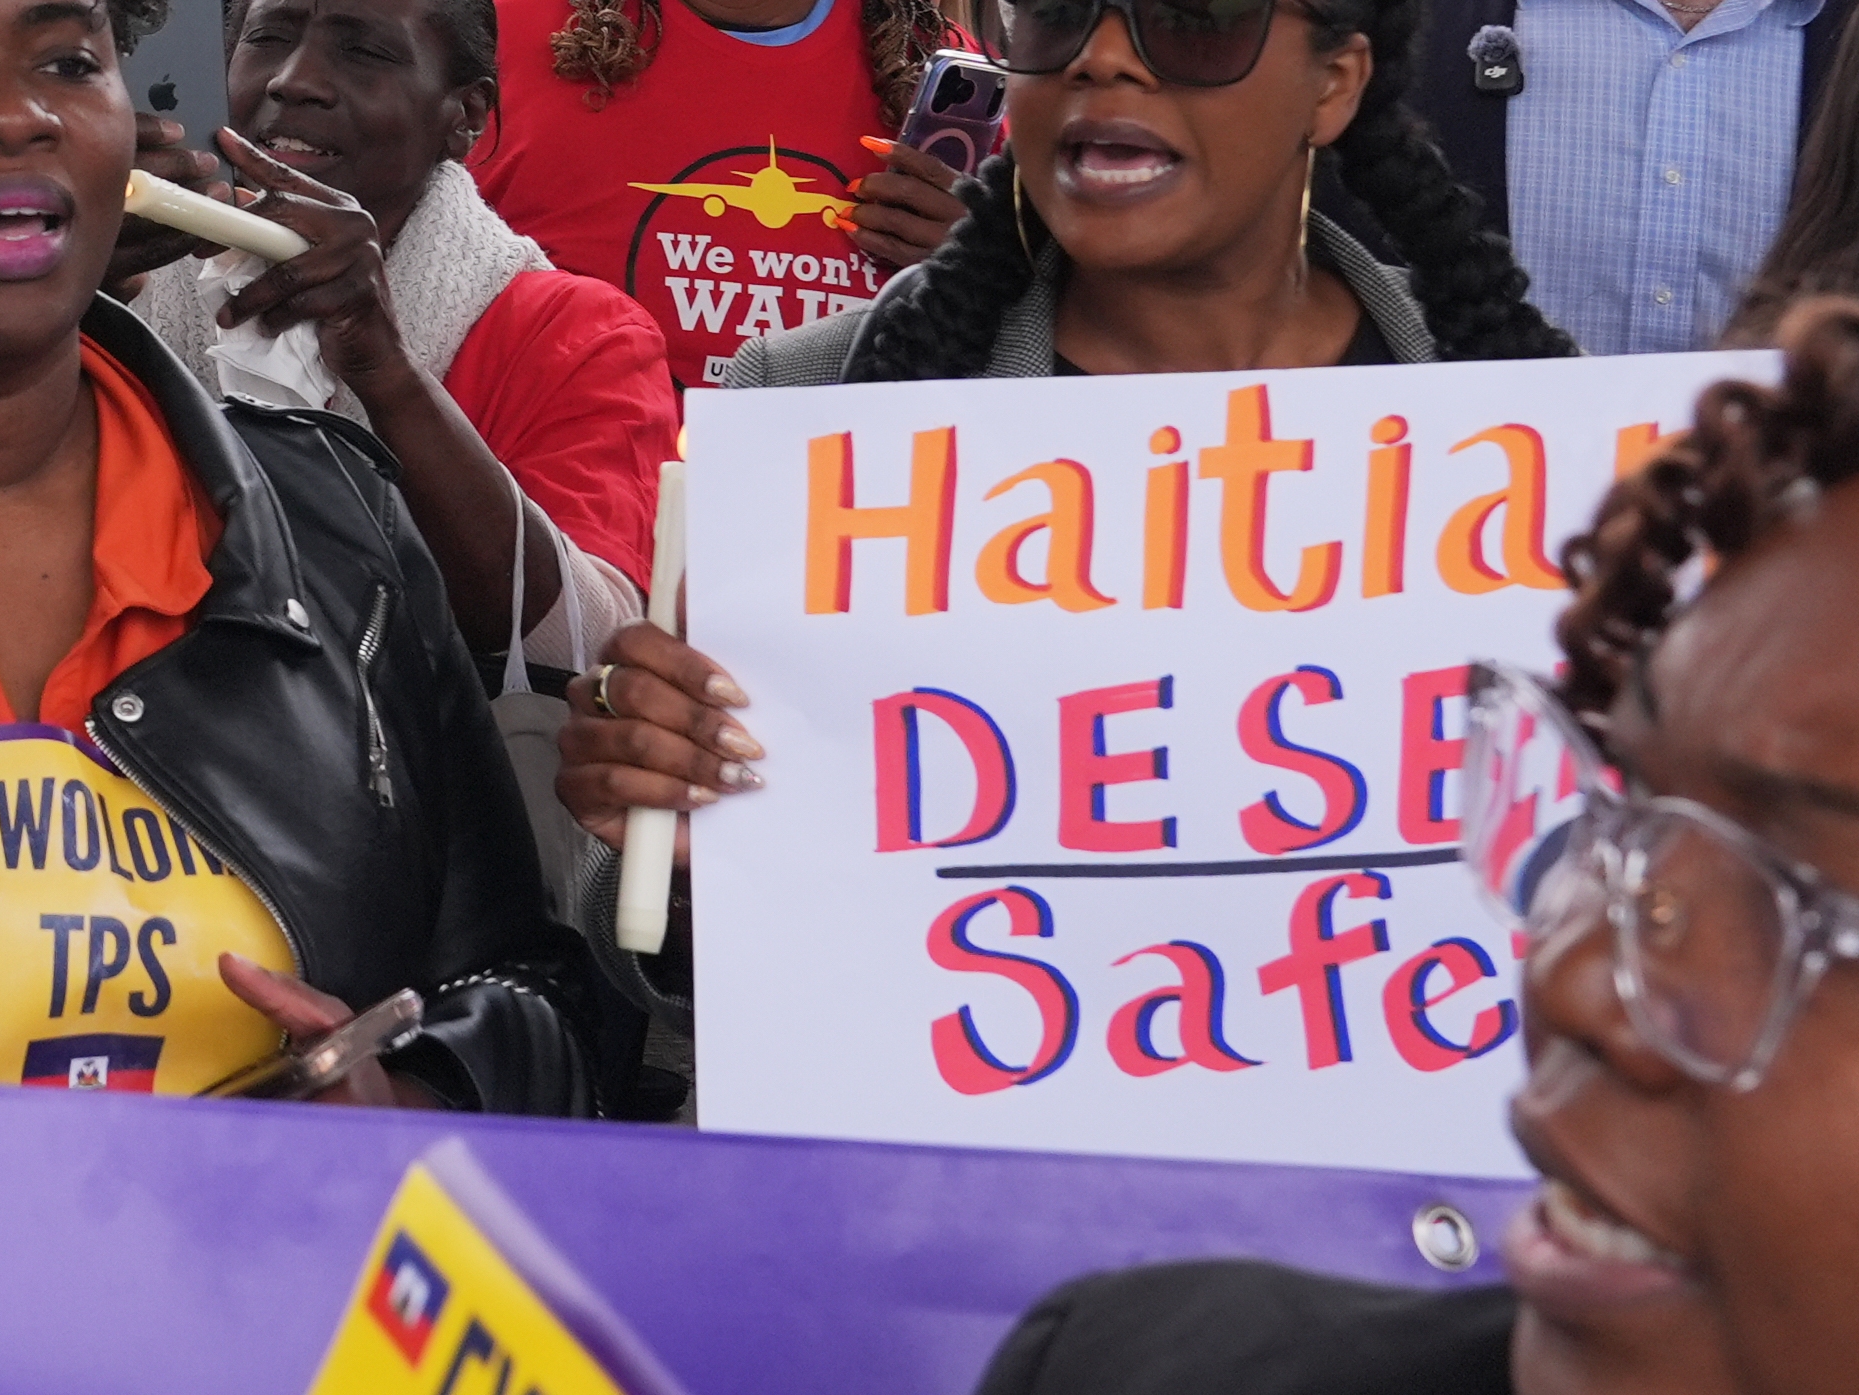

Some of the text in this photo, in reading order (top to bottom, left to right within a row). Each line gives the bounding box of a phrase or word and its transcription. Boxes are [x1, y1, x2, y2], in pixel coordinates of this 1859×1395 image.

[656, 231, 879, 293] We won't
[873, 665, 1530, 855] DESE
[40, 913, 176, 1019] TPS
[927, 868, 1528, 1096] Safe
